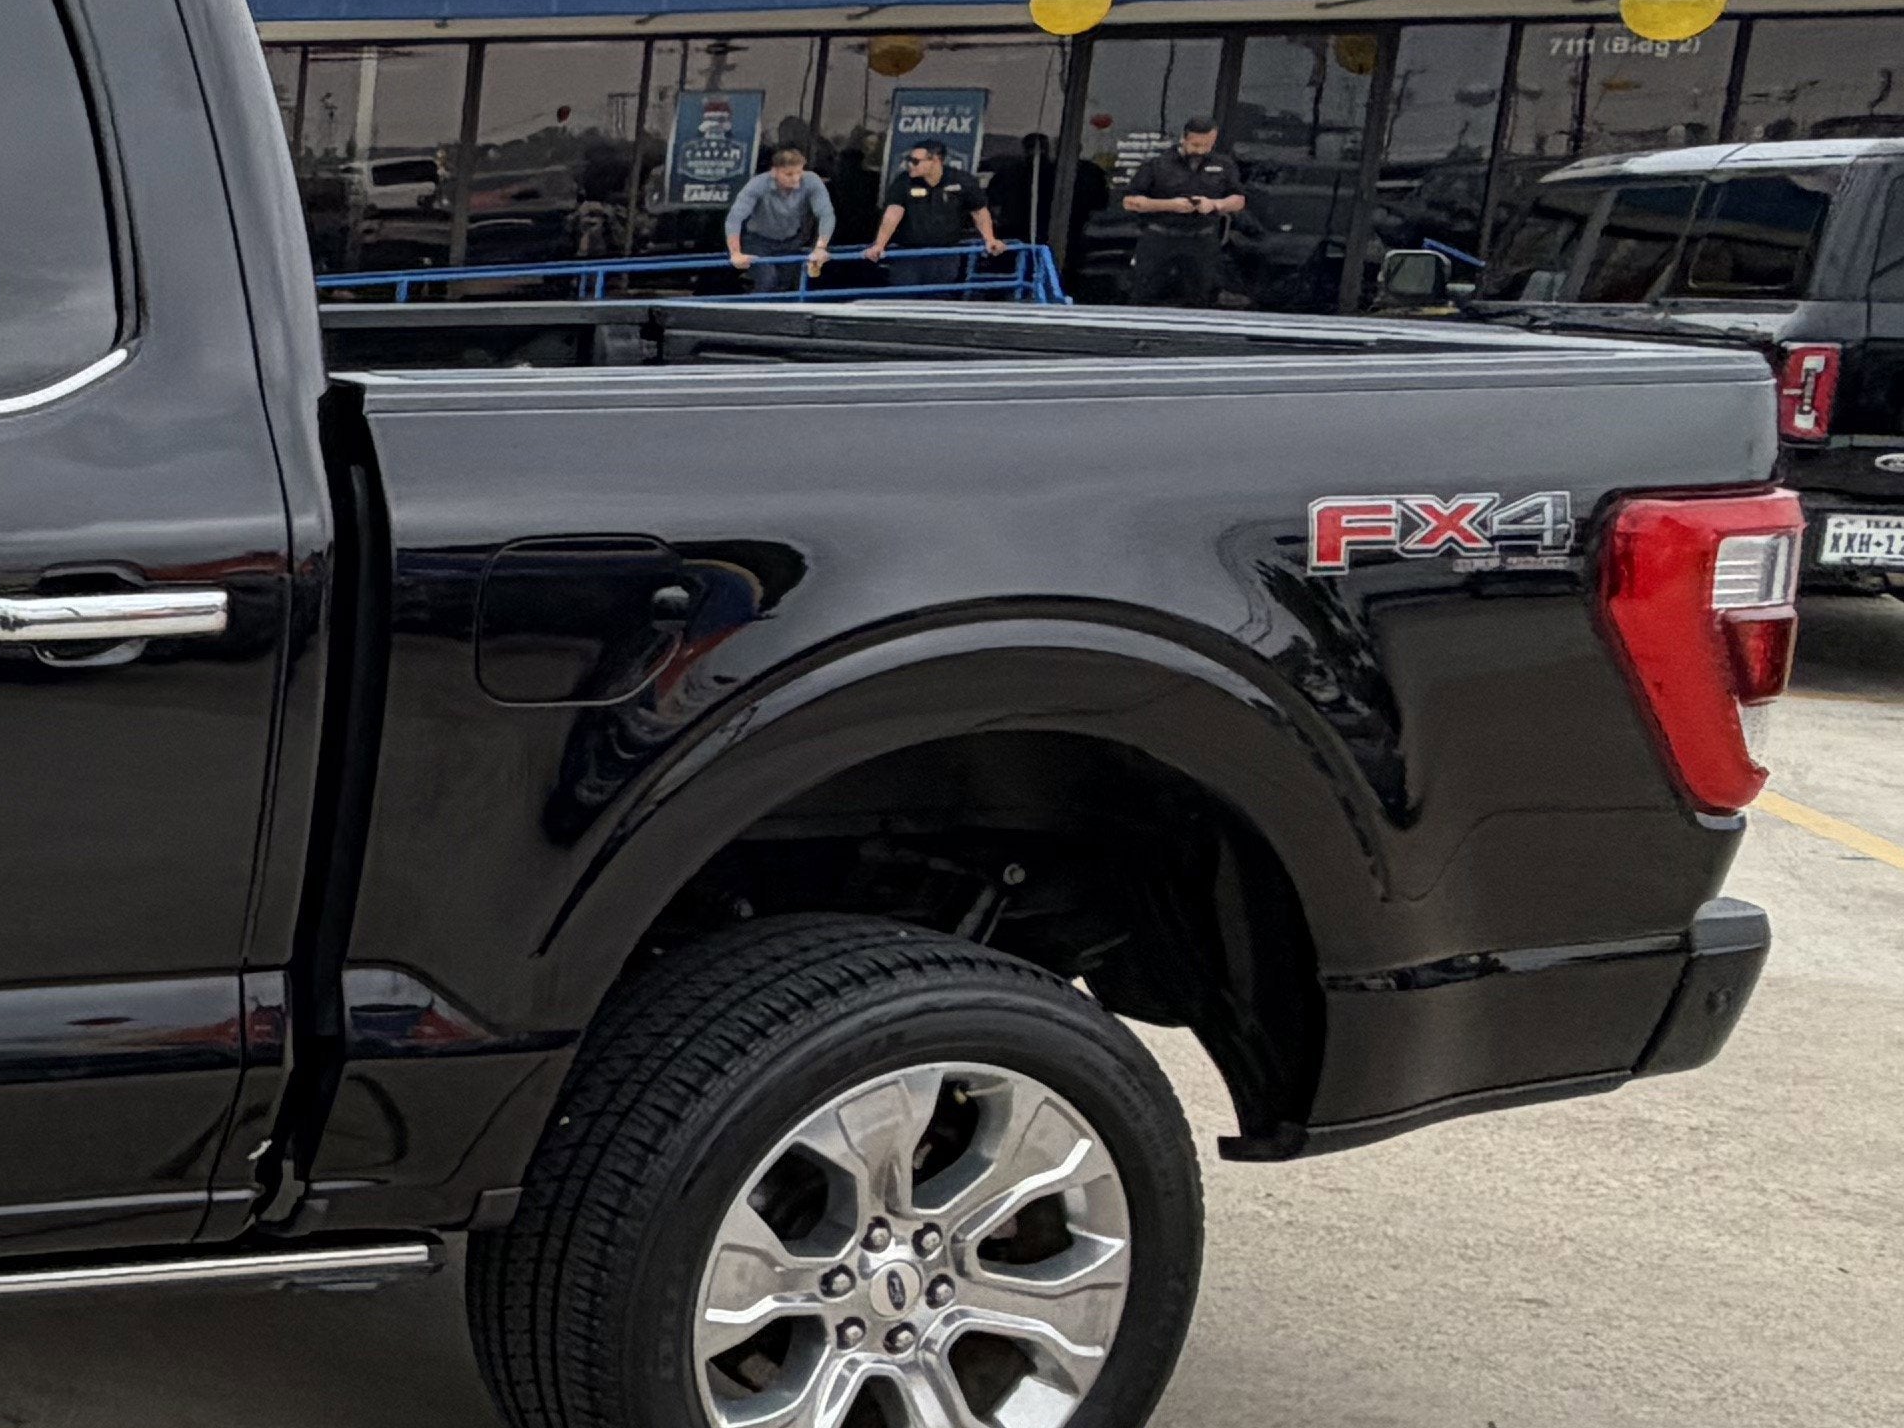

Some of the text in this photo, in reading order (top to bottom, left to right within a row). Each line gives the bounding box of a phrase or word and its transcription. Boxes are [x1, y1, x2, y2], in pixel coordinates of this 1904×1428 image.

[1549, 36, 1596, 57] 7111
[898, 116, 974, 134] CARFAX
[1306, 490, 1576, 576] FX4
[1866, 518, 1904, 529] TEXA
